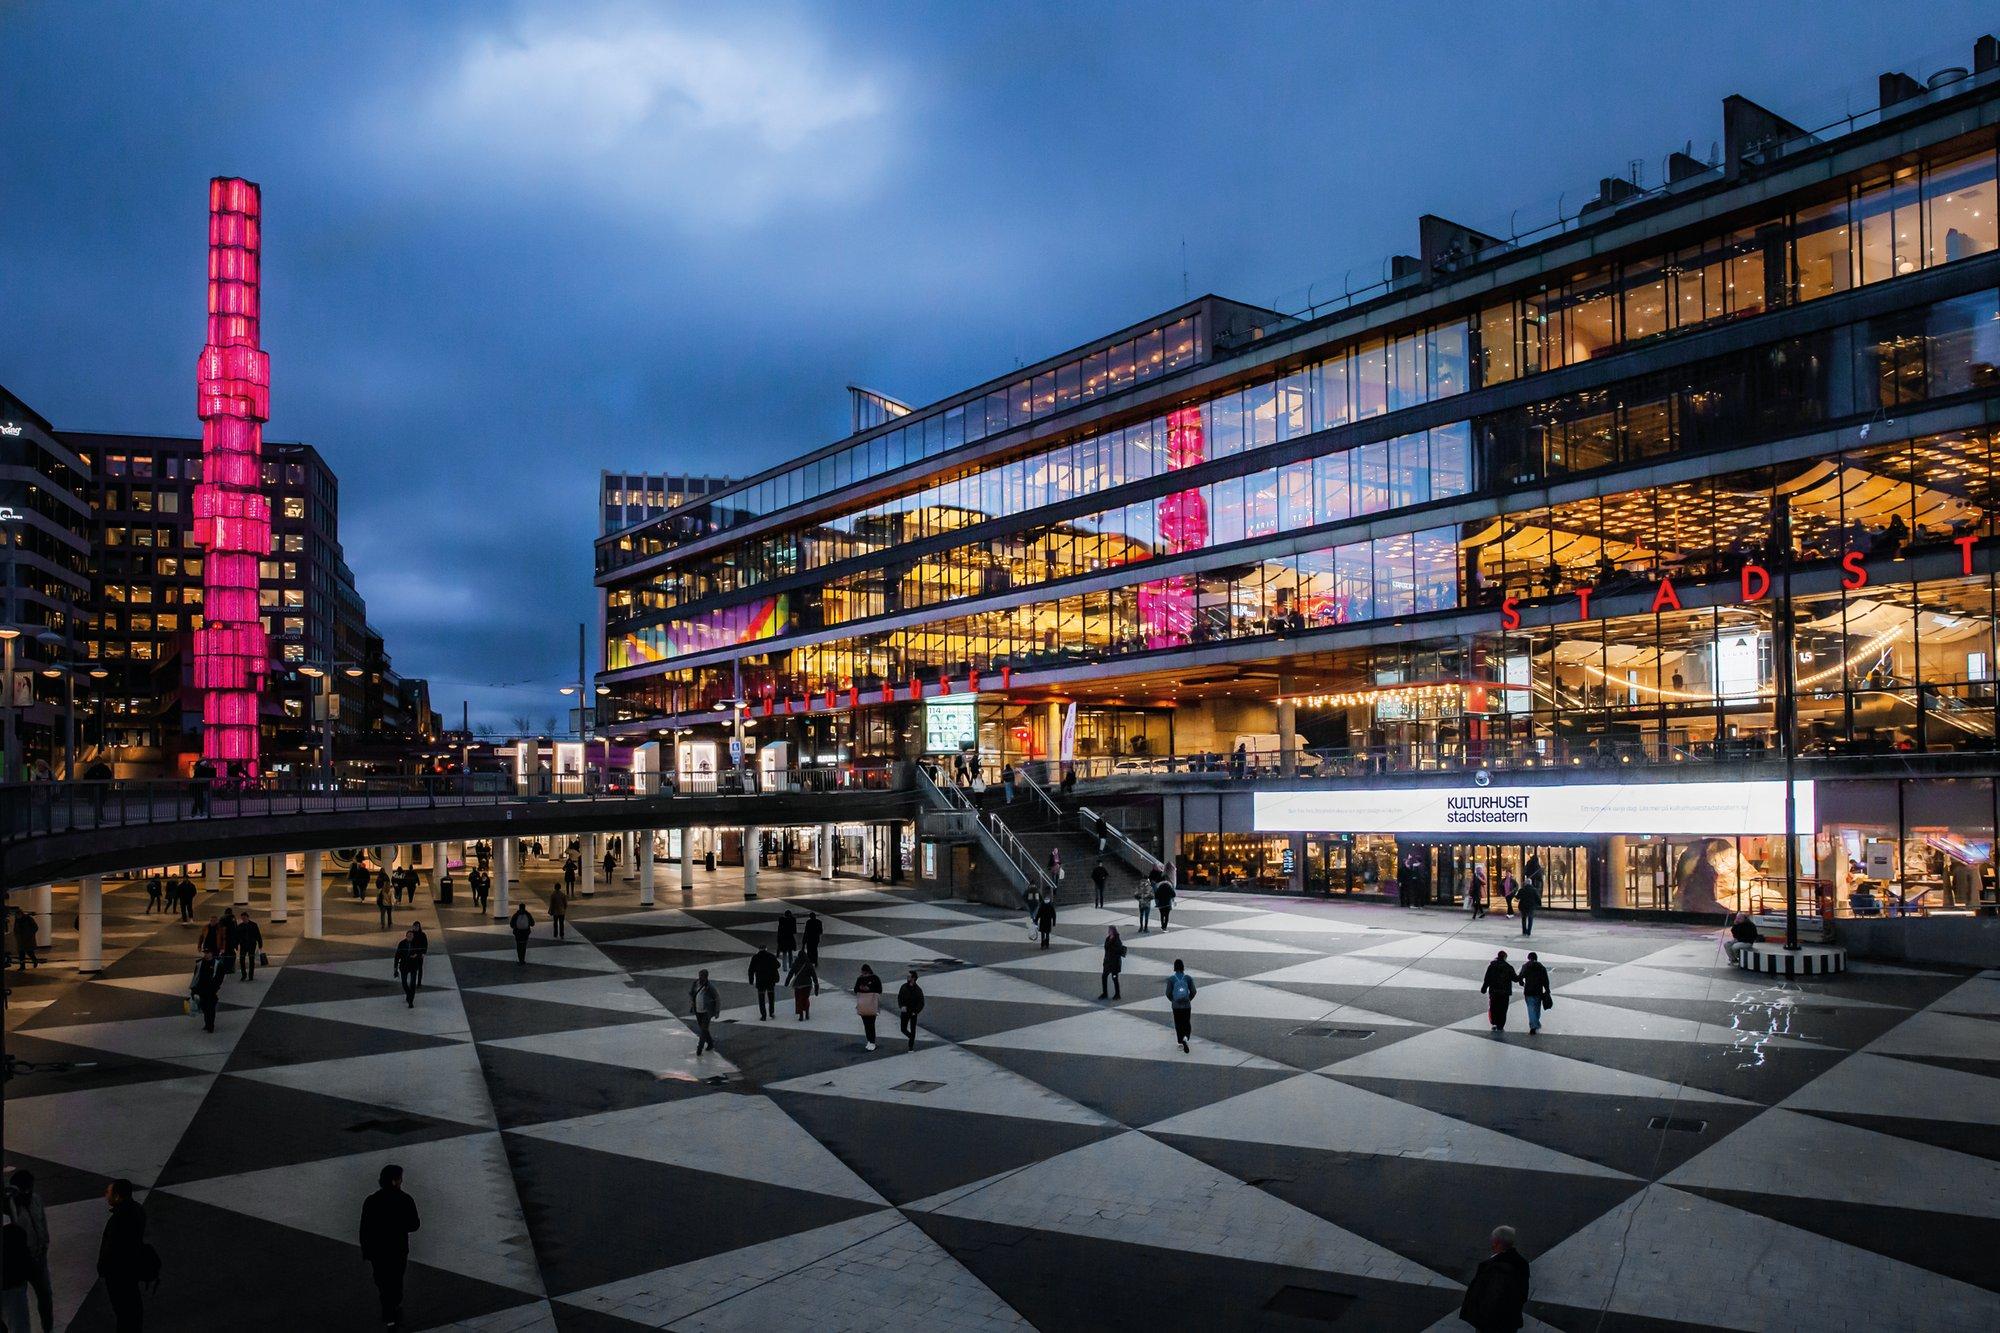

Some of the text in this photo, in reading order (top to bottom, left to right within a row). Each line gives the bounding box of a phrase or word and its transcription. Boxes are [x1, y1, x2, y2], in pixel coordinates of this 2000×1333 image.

[288, 507, 302, 517] EY
[1447, 796, 1530, 809] KULTURHUSET
[1447, 810, 1528, 822] stadsteatern
